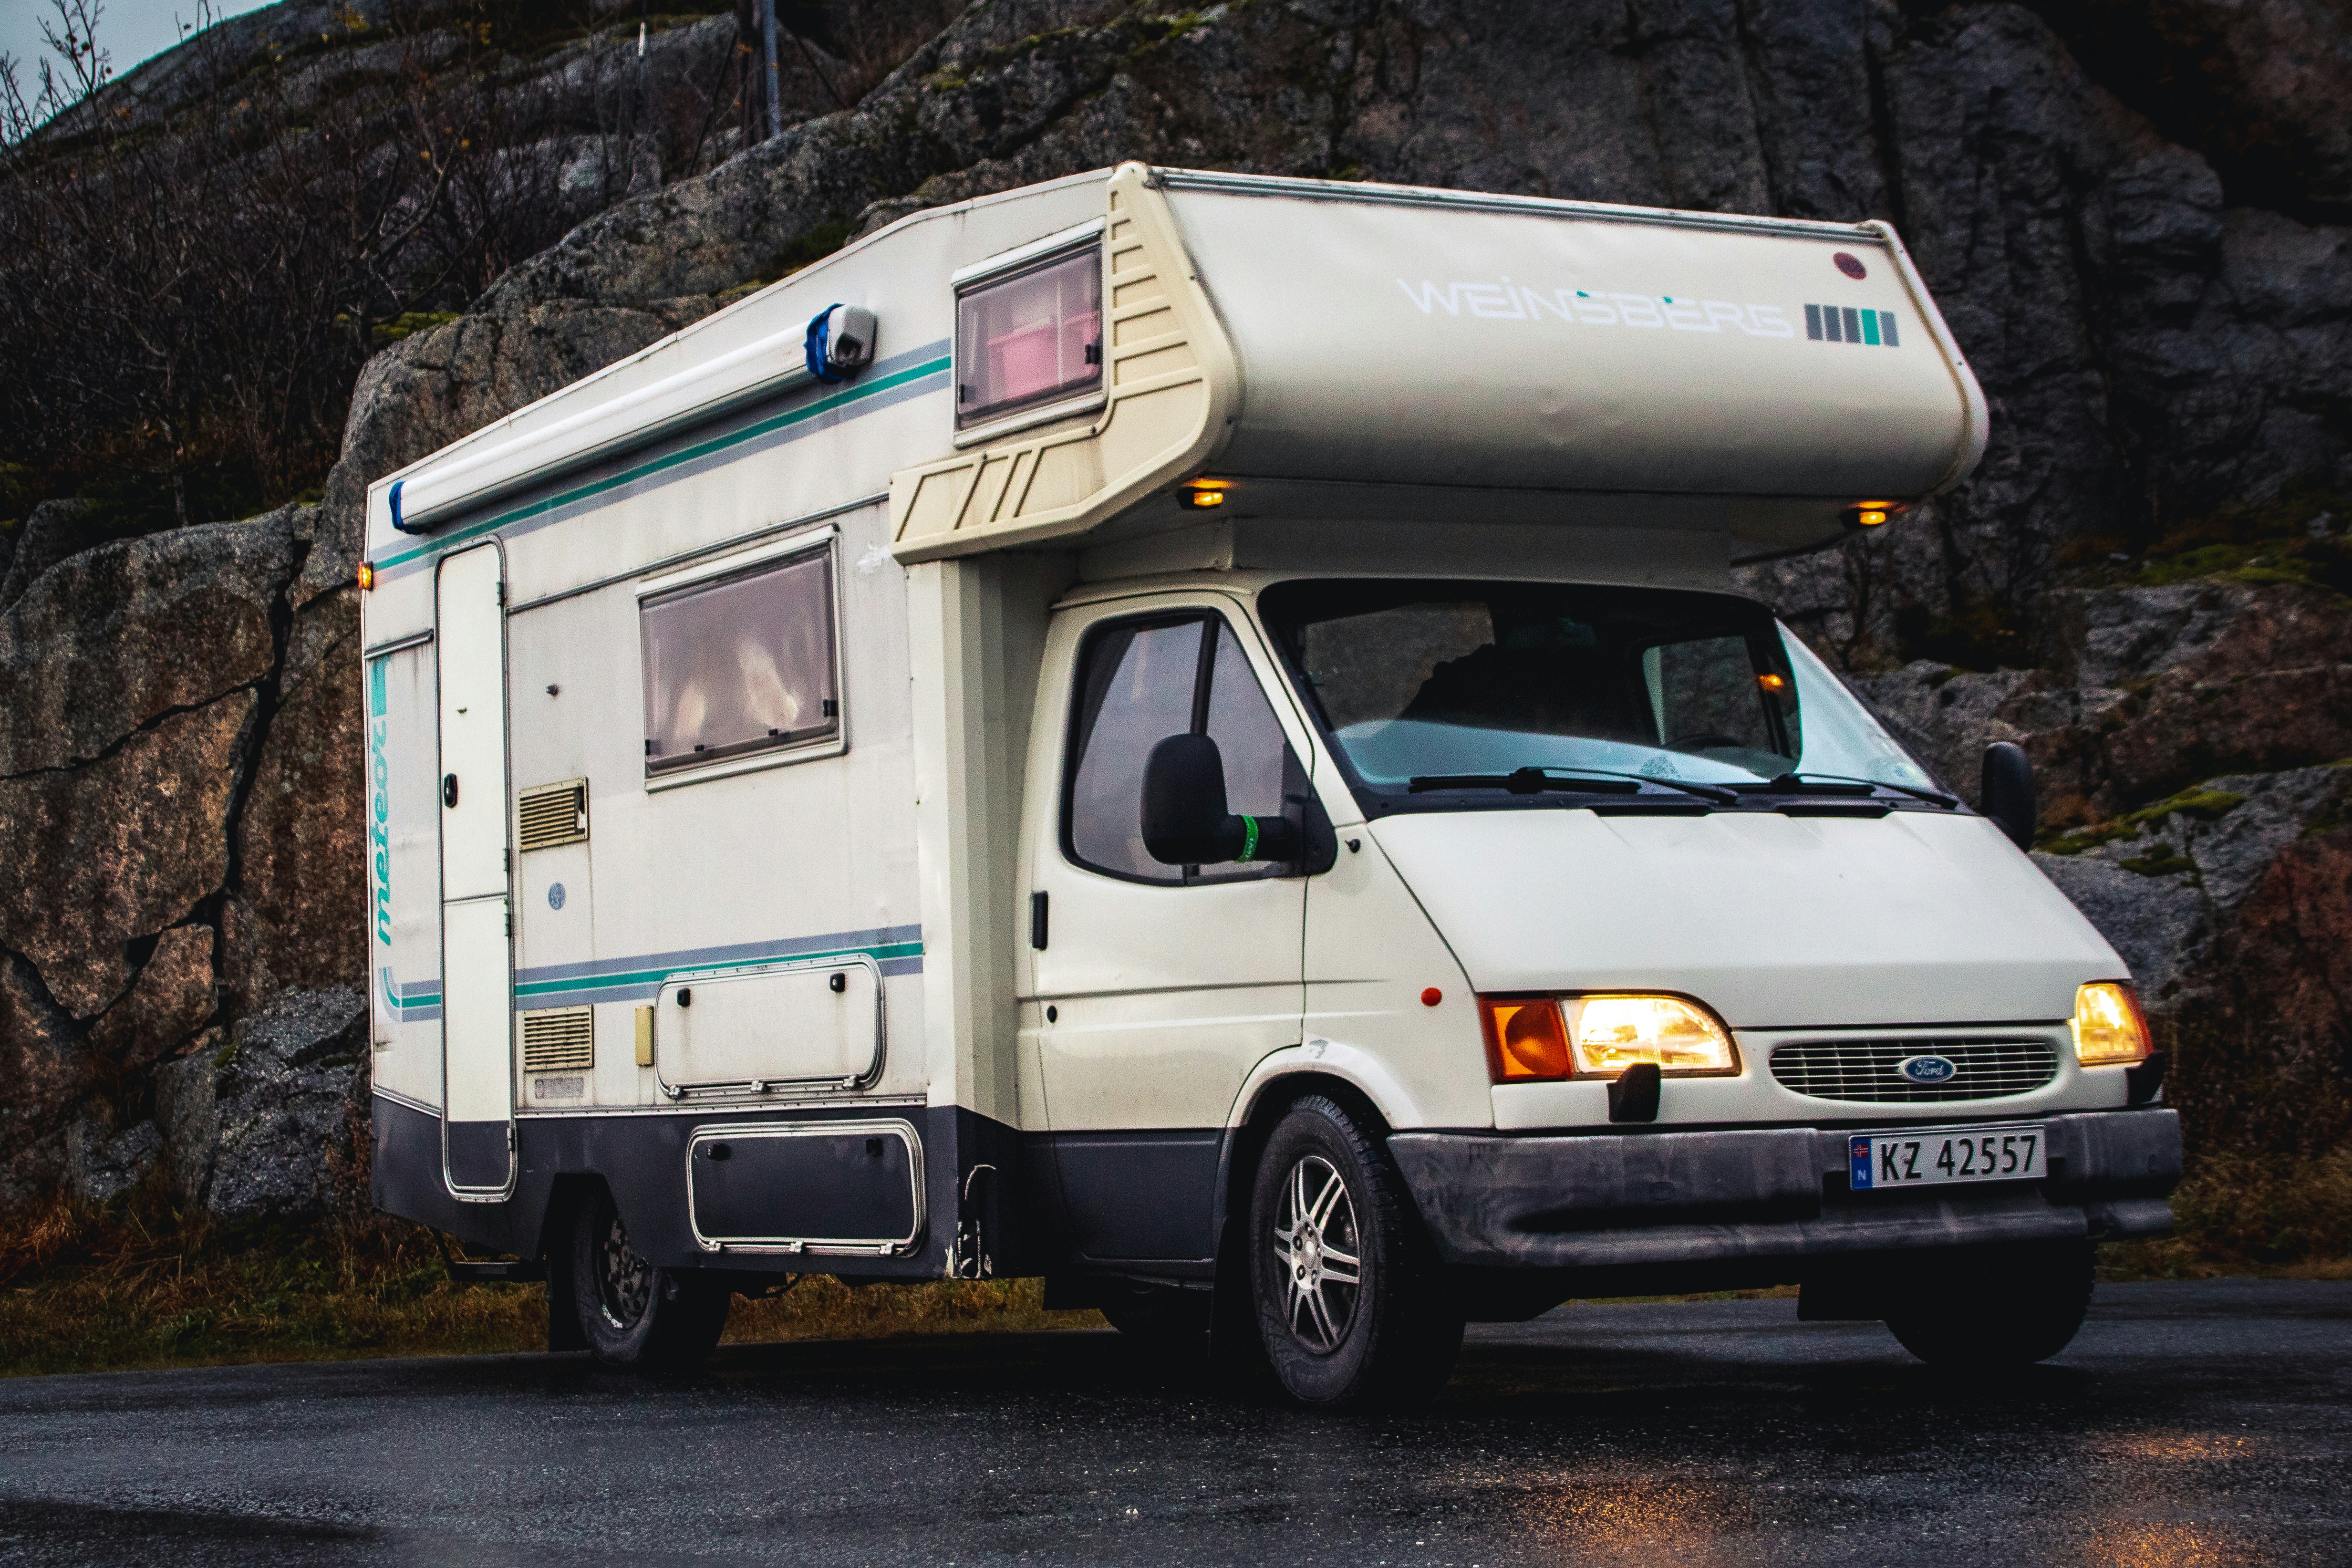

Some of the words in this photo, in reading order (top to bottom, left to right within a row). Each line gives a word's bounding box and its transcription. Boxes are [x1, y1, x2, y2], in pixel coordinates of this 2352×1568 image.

[371, 719, 391, 946] meteor
[1915, 1060, 1945, 1075] Ford
[1881, 1141, 1922, 1181] KZ
[1937, 1134, 2036, 1177] 42557
[1857, 1170, 1866, 1181] N
